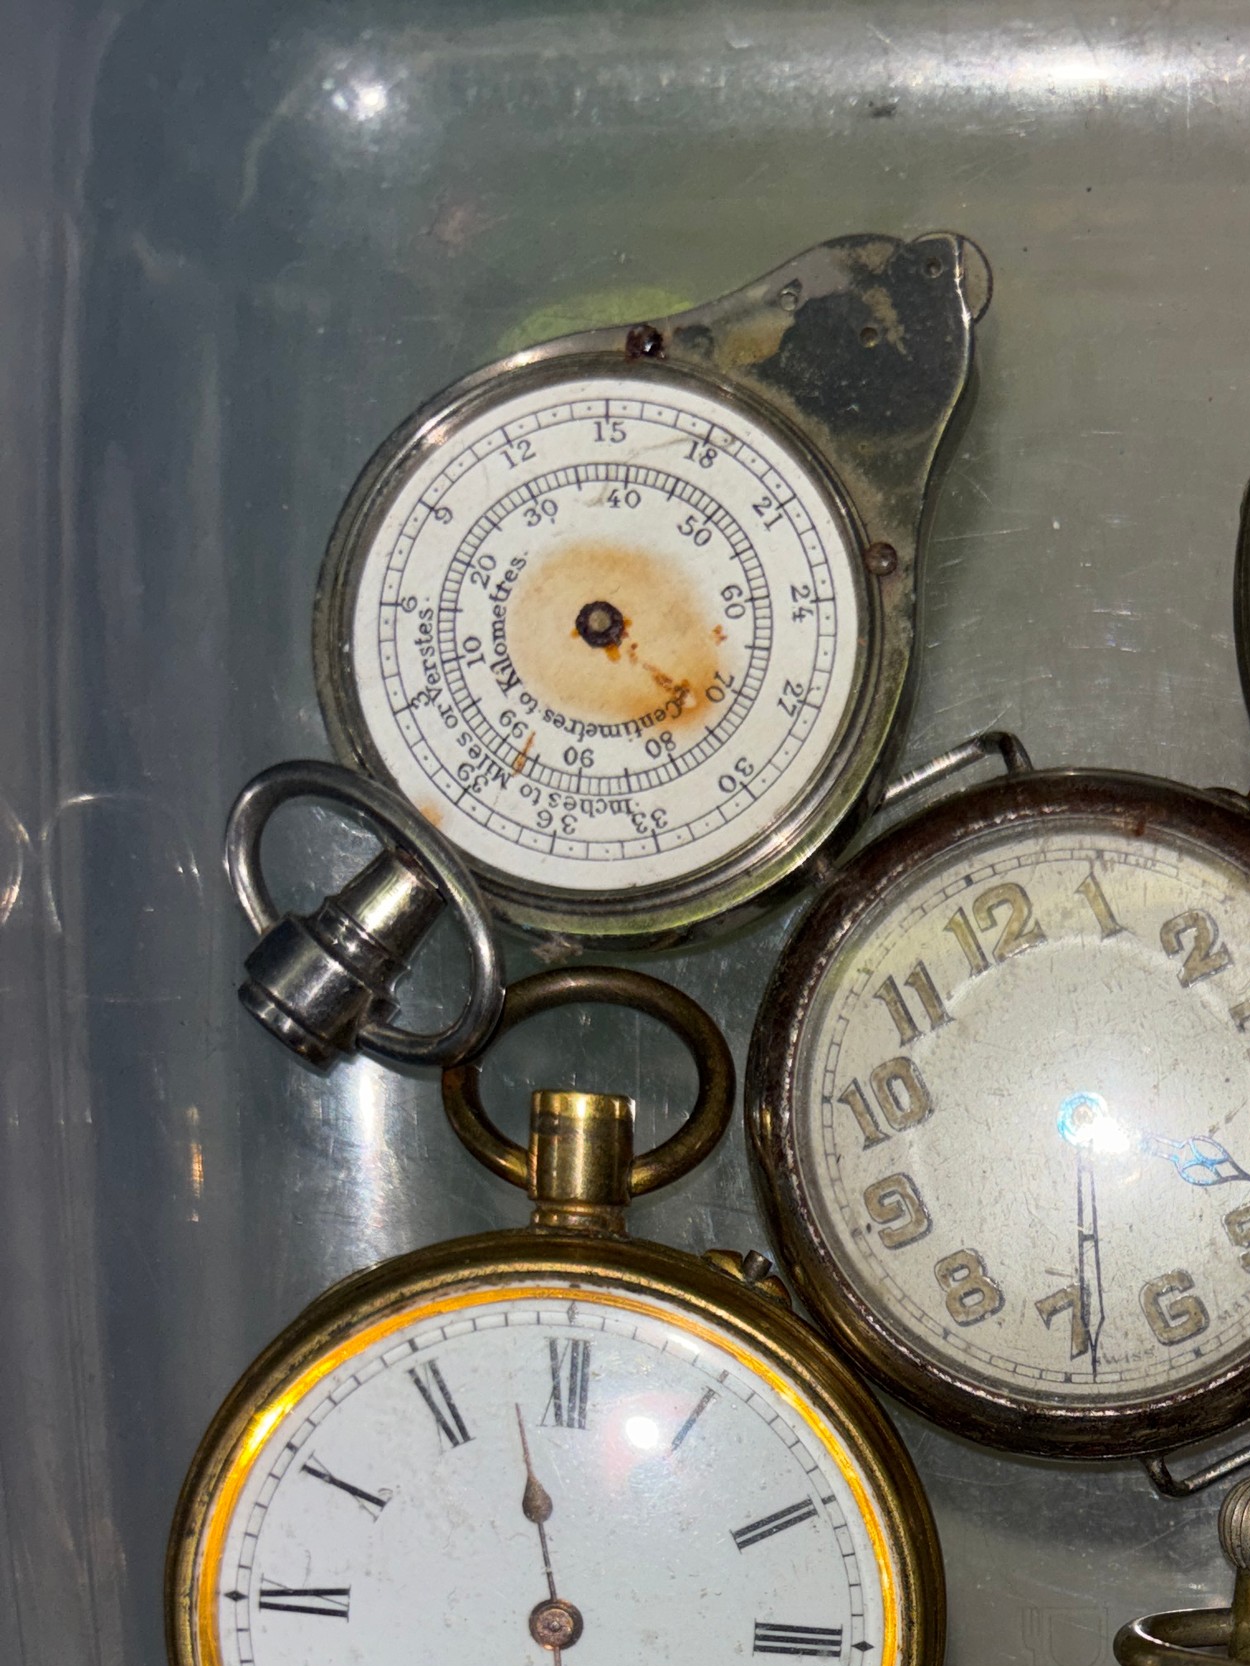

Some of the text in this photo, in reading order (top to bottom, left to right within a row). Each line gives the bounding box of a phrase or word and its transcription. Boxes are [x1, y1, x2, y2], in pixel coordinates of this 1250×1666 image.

[593, 421, 627, 443] 15
[500, 439, 536, 470] 12
[683, 440, 718, 469] 18
[523, 499, 558, 527] 30
[606, 488, 642, 509] 40
[752, 496, 784, 532] 21
[677, 515, 712, 547] 50
[470, 555, 497, 590] 20
[720, 584, 746, 620] 60
[790, 584, 814, 623] 24
[463, 636, 486, 669] 10
[519, 692, 539, 715] to
[705, 671, 735, 703] 70
[777, 679, 804, 718] 27
[437, 702, 459, 729] or
[499, 709, 529, 739] 99
[457, 731, 515, 790] Miles
[563, 746, 595, 768] 90
[645, 730, 677, 760] 80
[457, 762, 489, 794] 39
[718, 757, 754, 793] 30
[519, 783, 542, 806] to
[536, 809, 578, 835] 36
[631, 808, 668, 834] 33
[1075, 872, 1126, 940] 1
[943, 881, 1048, 978] 12
[1158, 907, 1234, 989] 2
[872, 959, 955, 1047] 11
[837, 1055, 935, 1151] 10
[863, 1171, 934, 1250] 9
[932, 1247, 1006, 1327] 8
[1034, 1281, 1090, 1361] 7
[1138, 1268, 1211, 1347] 6
